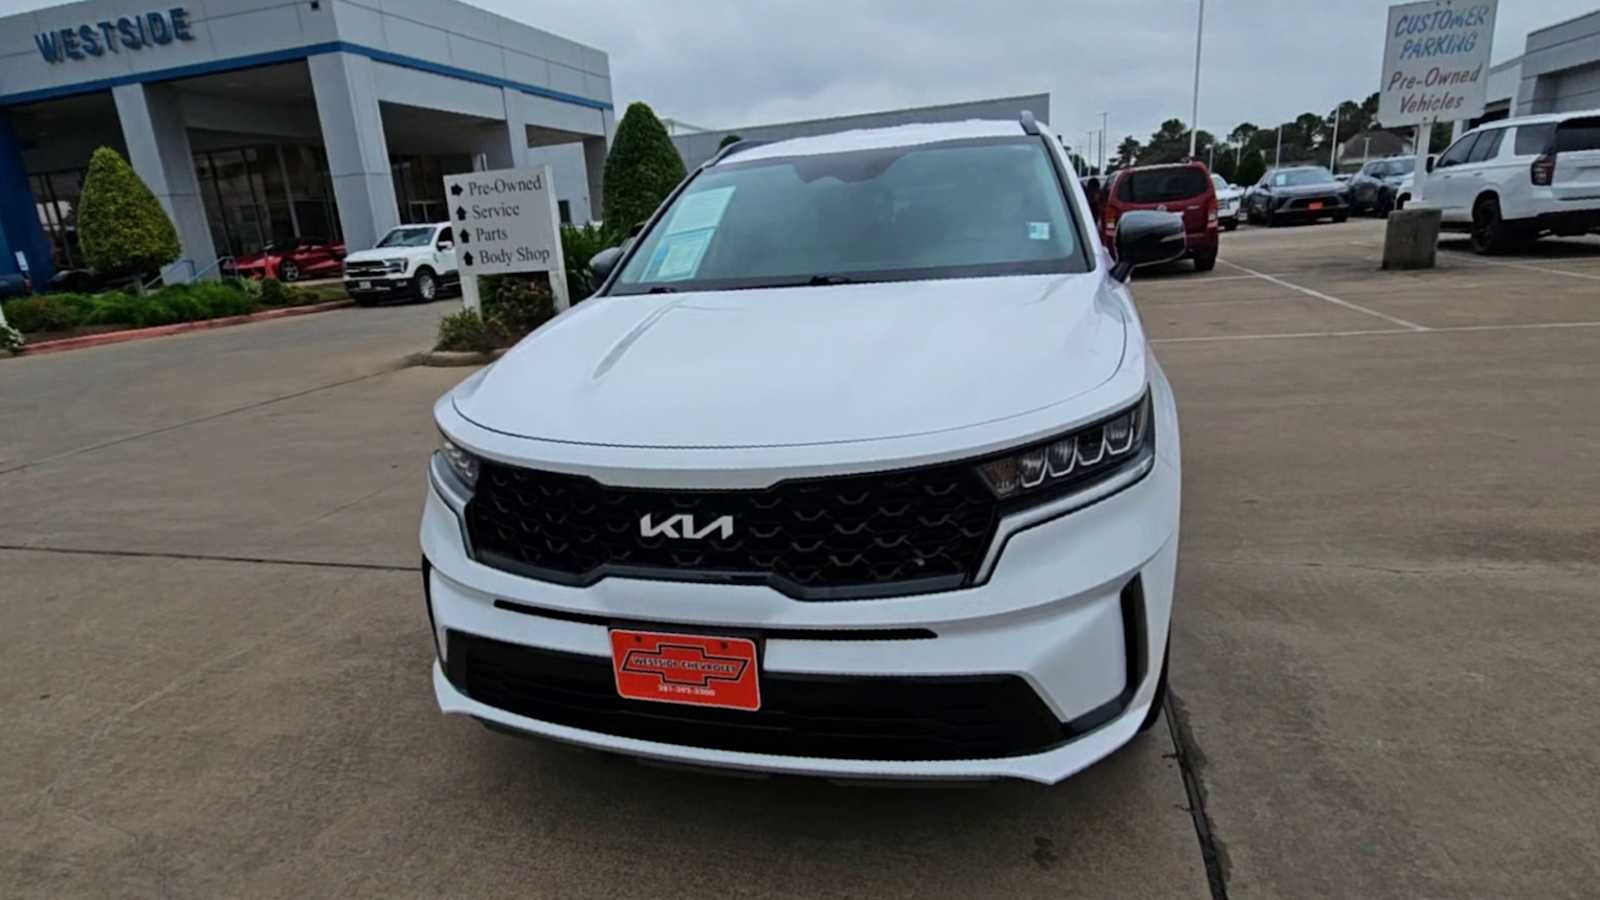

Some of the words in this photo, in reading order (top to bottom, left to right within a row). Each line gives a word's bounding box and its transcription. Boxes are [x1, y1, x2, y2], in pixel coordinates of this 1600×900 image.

[34, 8, 194, 64] WESTSIDE
[1400, 32, 1478, 59] PARKING
[1387, 64, 1482, 92] Pre-Owned
[1400, 92, 1464, 114] Vehicles
[468, 175, 542, 196] Pre-Owned
[472, 203, 520, 220] Service
[476, 227, 509, 242] Parts
[479, 248, 513, 266] Body
[516, 245, 550, 264] Shop
[640, 512, 734, 540] KIA
